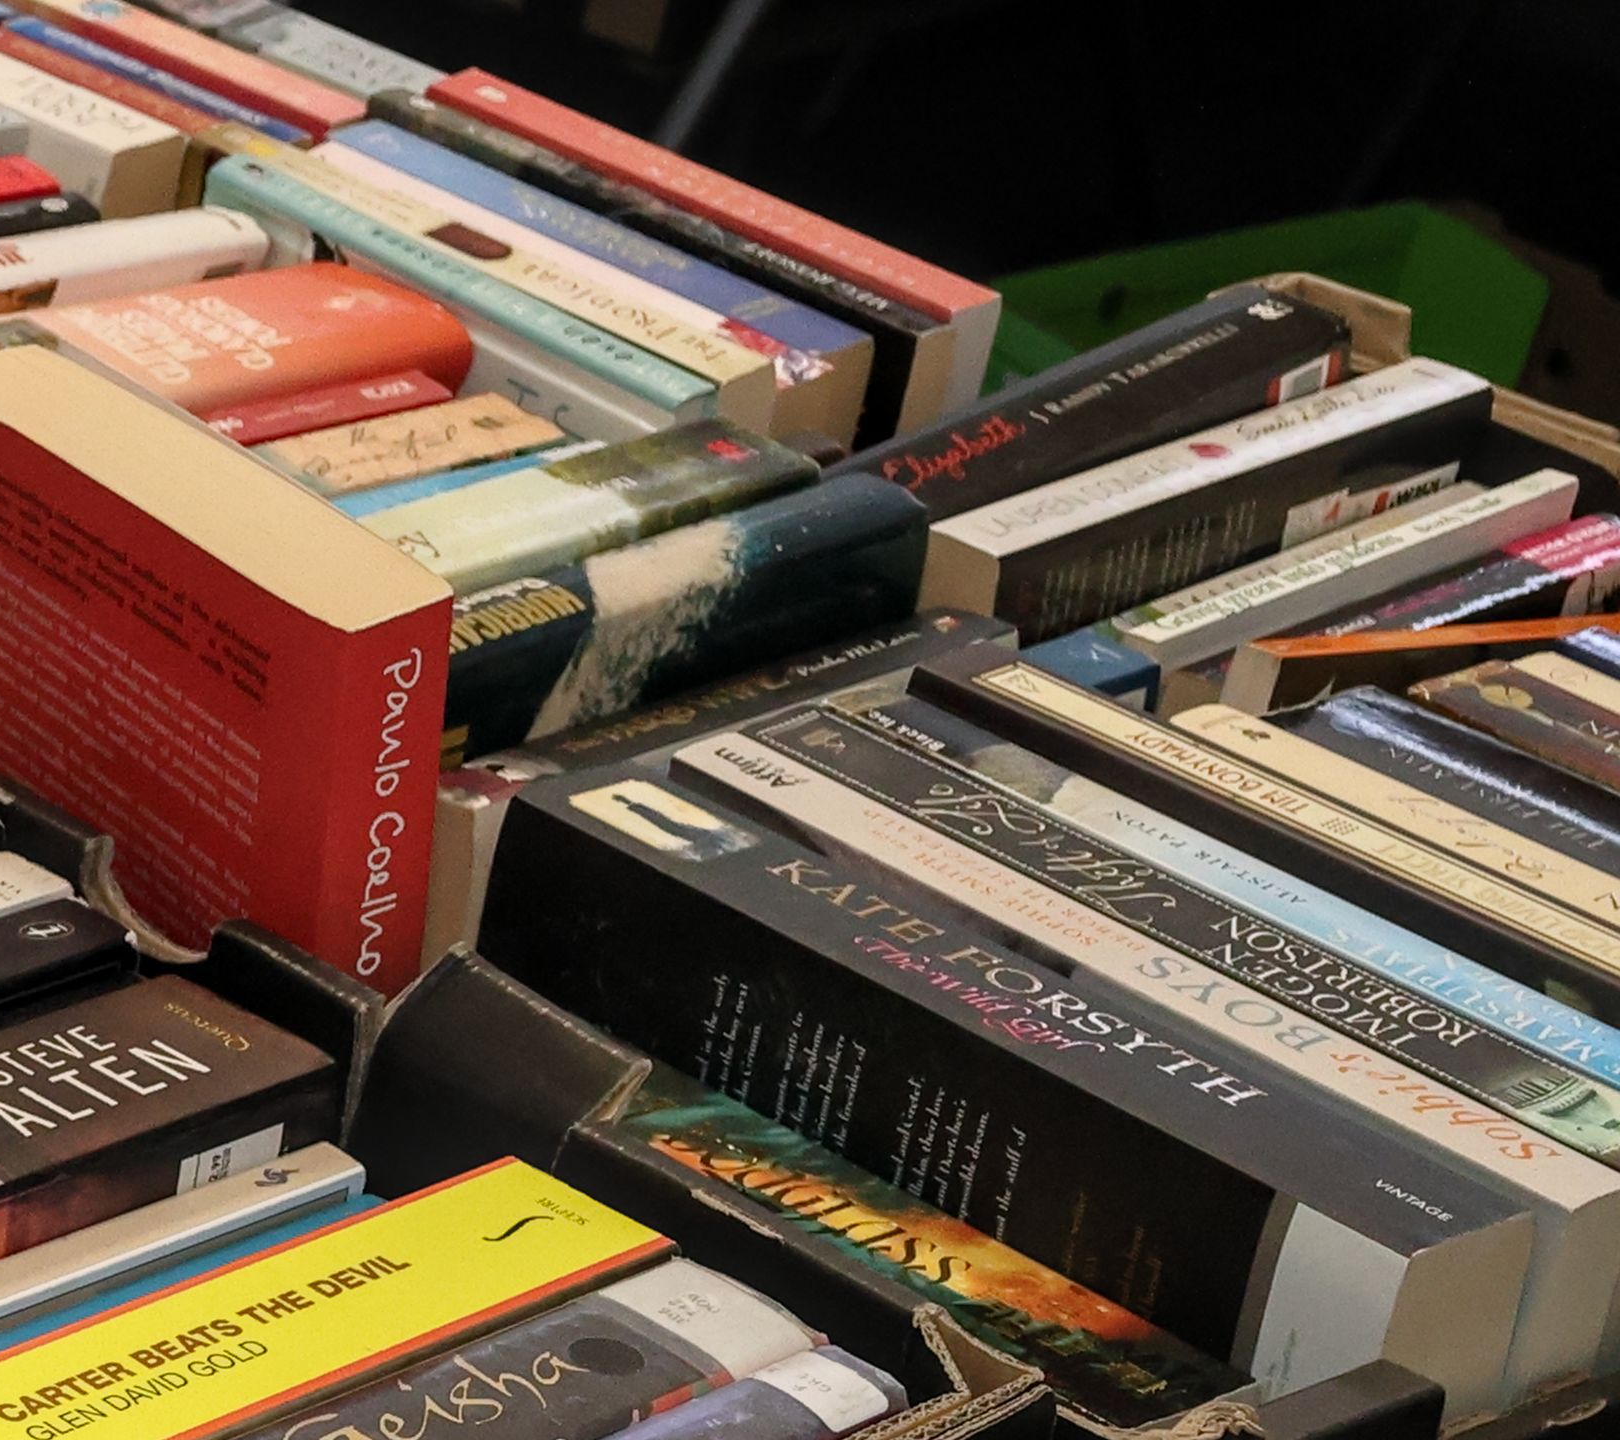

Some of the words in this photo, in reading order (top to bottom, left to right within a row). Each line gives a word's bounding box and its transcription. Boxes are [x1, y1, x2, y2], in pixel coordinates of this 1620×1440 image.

[375, 647, 423, 799] Paulo
[1264, 786, 1312, 816] TIM
[355, 808, 405, 977] Coelho
[766, 858, 945, 946] KATE
[943, 943, 1268, 1108] FORSYTH
[1210, 914, 1478, 1048] ROBERTSON
[1210, 942, 1417, 1049] IMOGEN
[1373, 1176, 1454, 1224] VINTAGE
[136, 1316, 242, 1374] BEATS
[244, 1284, 310, 1339] THE
[310, 1252, 413, 1313] DEVIL
[100, 1368, 191, 1416] DAVID
[196, 1338, 269, 1383] GOLD
